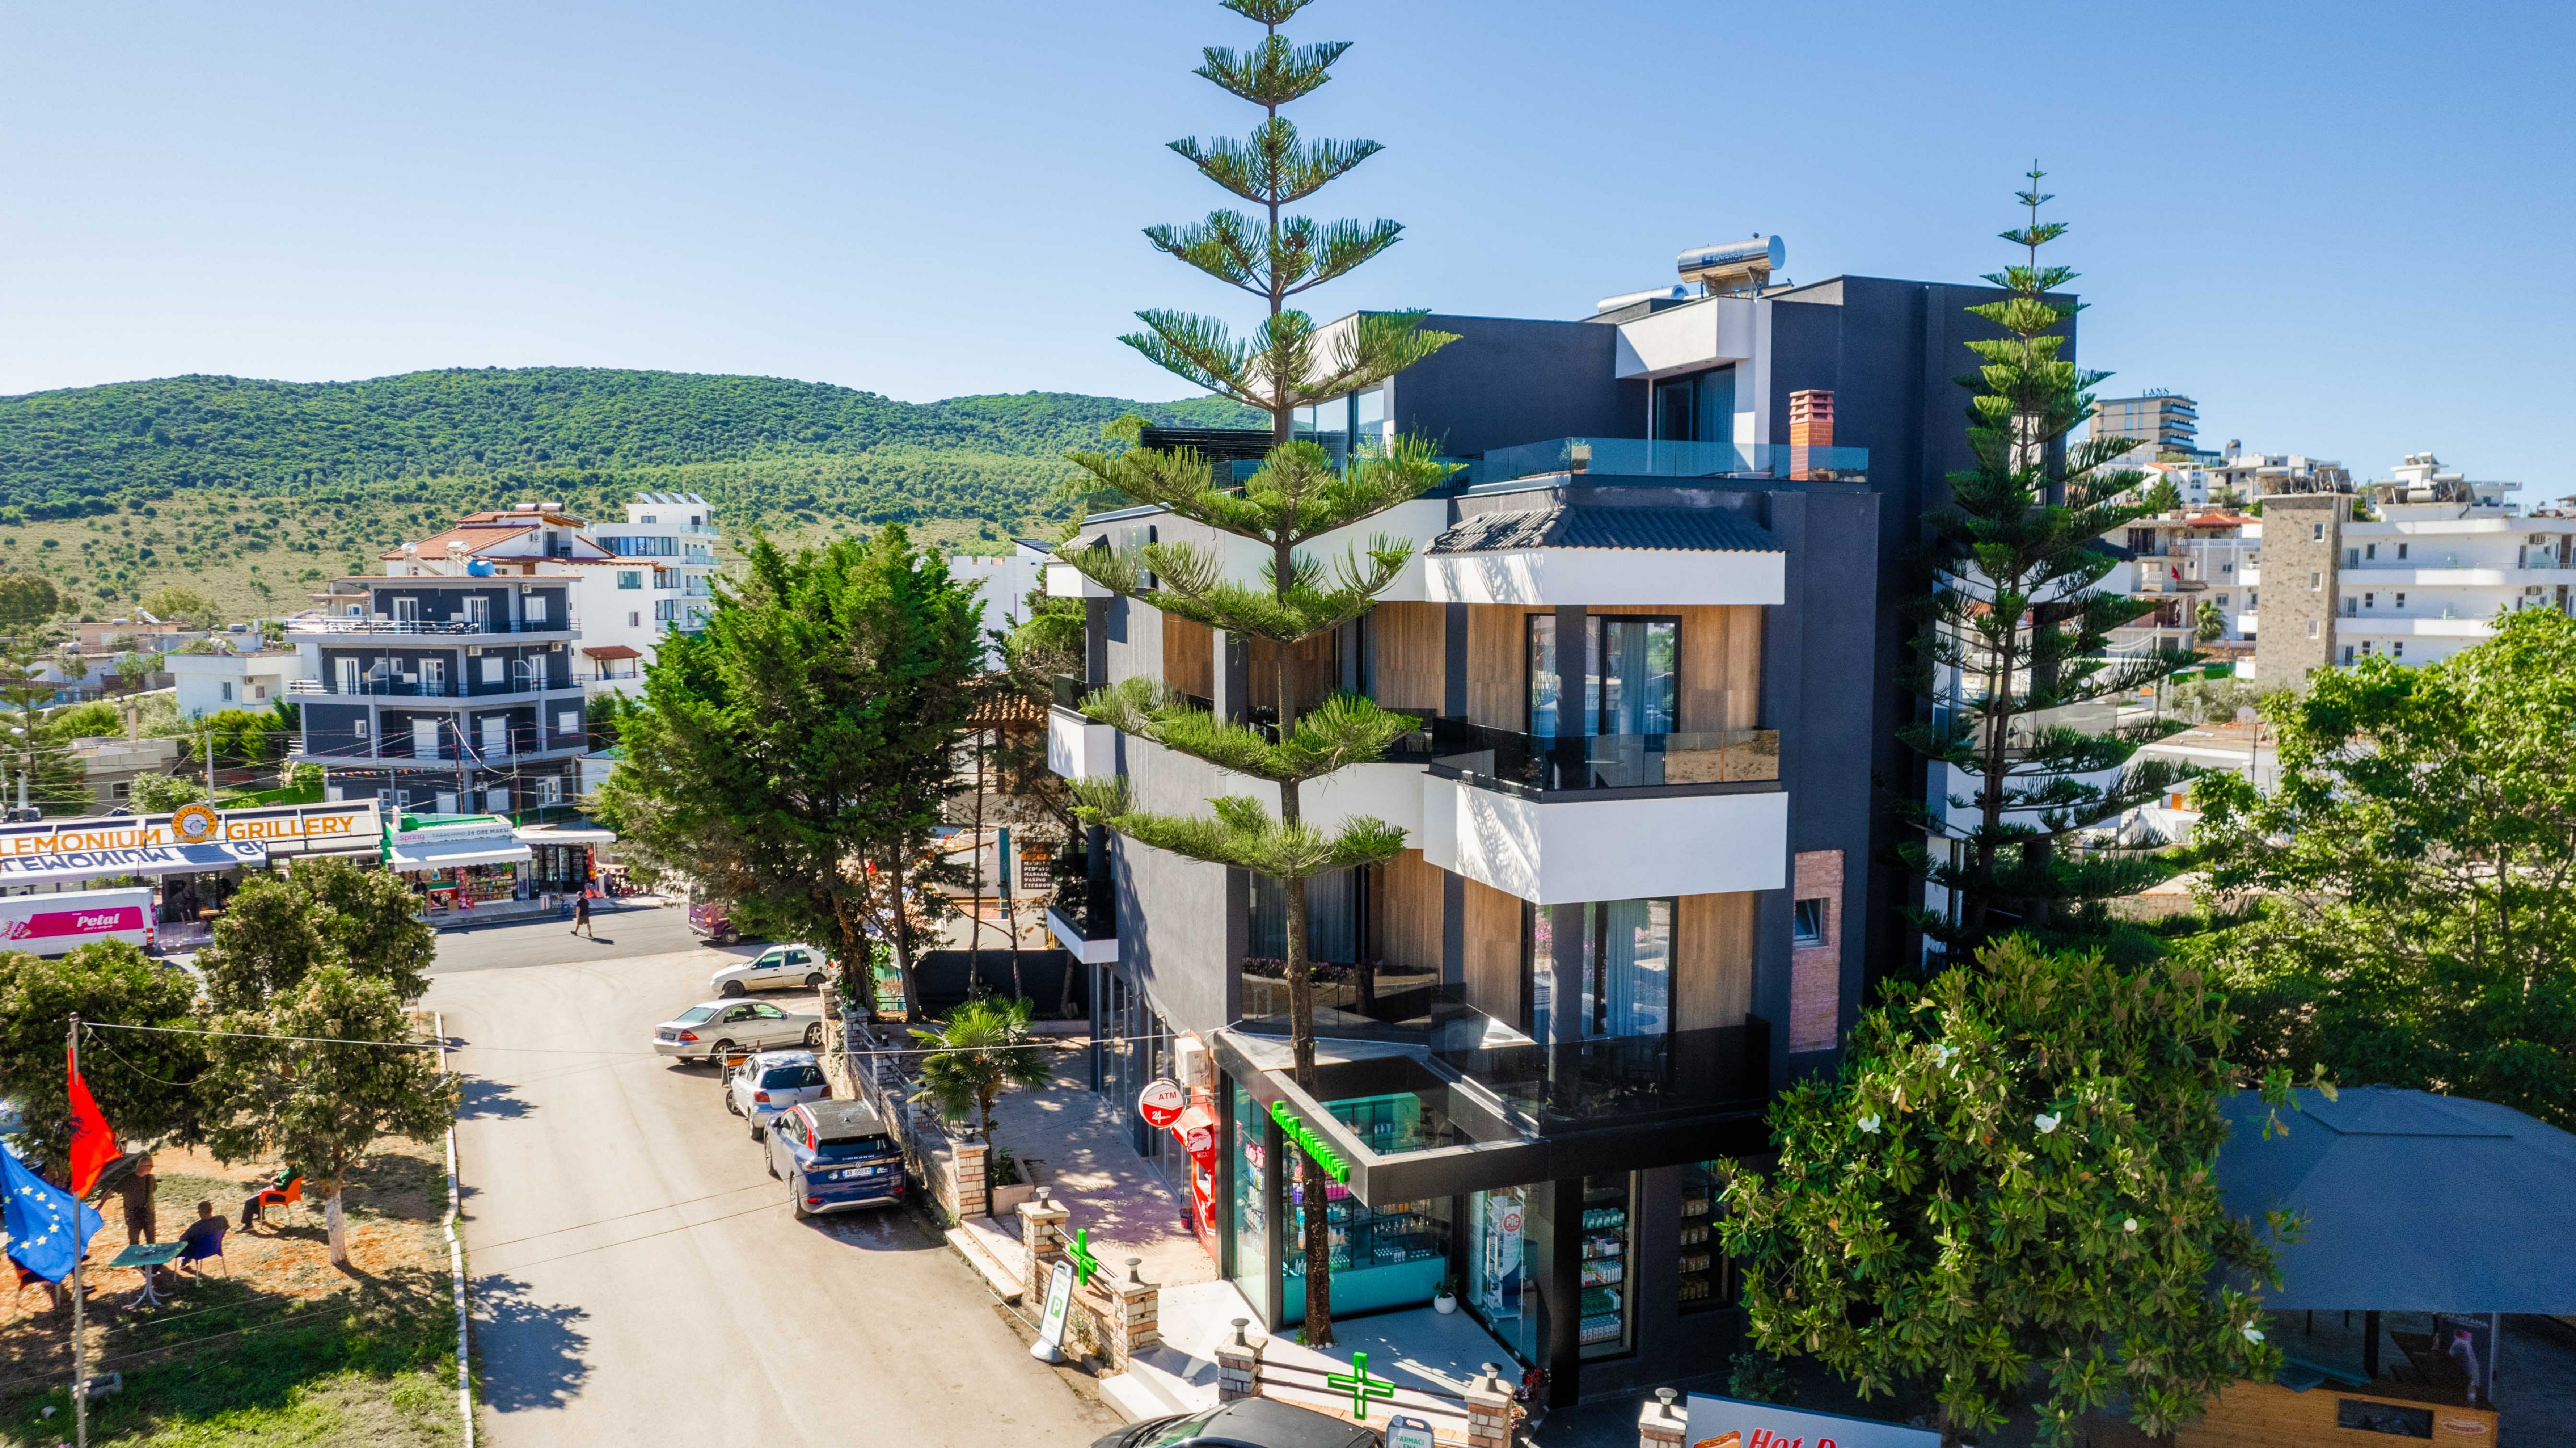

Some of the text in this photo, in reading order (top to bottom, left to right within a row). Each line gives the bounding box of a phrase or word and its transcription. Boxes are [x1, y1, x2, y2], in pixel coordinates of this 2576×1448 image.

[1714, 253, 1743, 263] ENERGY
[2143, 388, 2169, 396] LANS
[227, 816, 354, 840] GRILLERY
[0, 829, 161, 856] LEMONIUM
[77, 913, 120, 927] Petal
[1158, 1092, 1176, 1100] ATM
[1396, 1435, 1424, 1445] FARMACI
